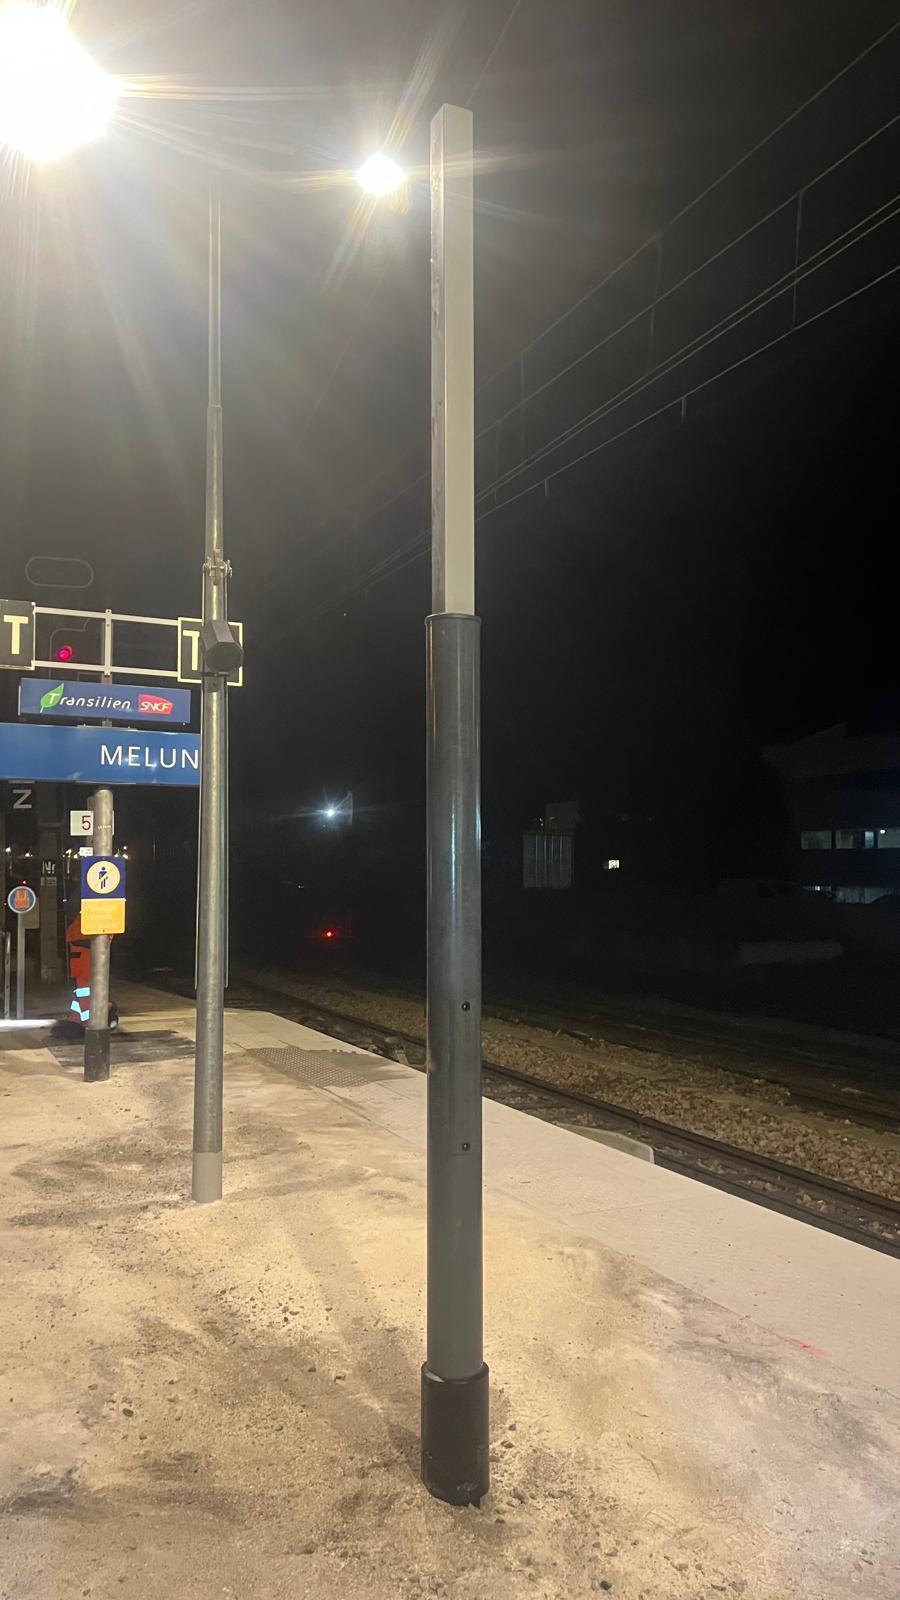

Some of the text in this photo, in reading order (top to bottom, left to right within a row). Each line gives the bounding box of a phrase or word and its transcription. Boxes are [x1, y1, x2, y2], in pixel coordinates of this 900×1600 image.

[4, 615, 29, 654] T
[48, 692, 171, 712] Transilien SNCF
[100, 745, 199, 769] MELUN
